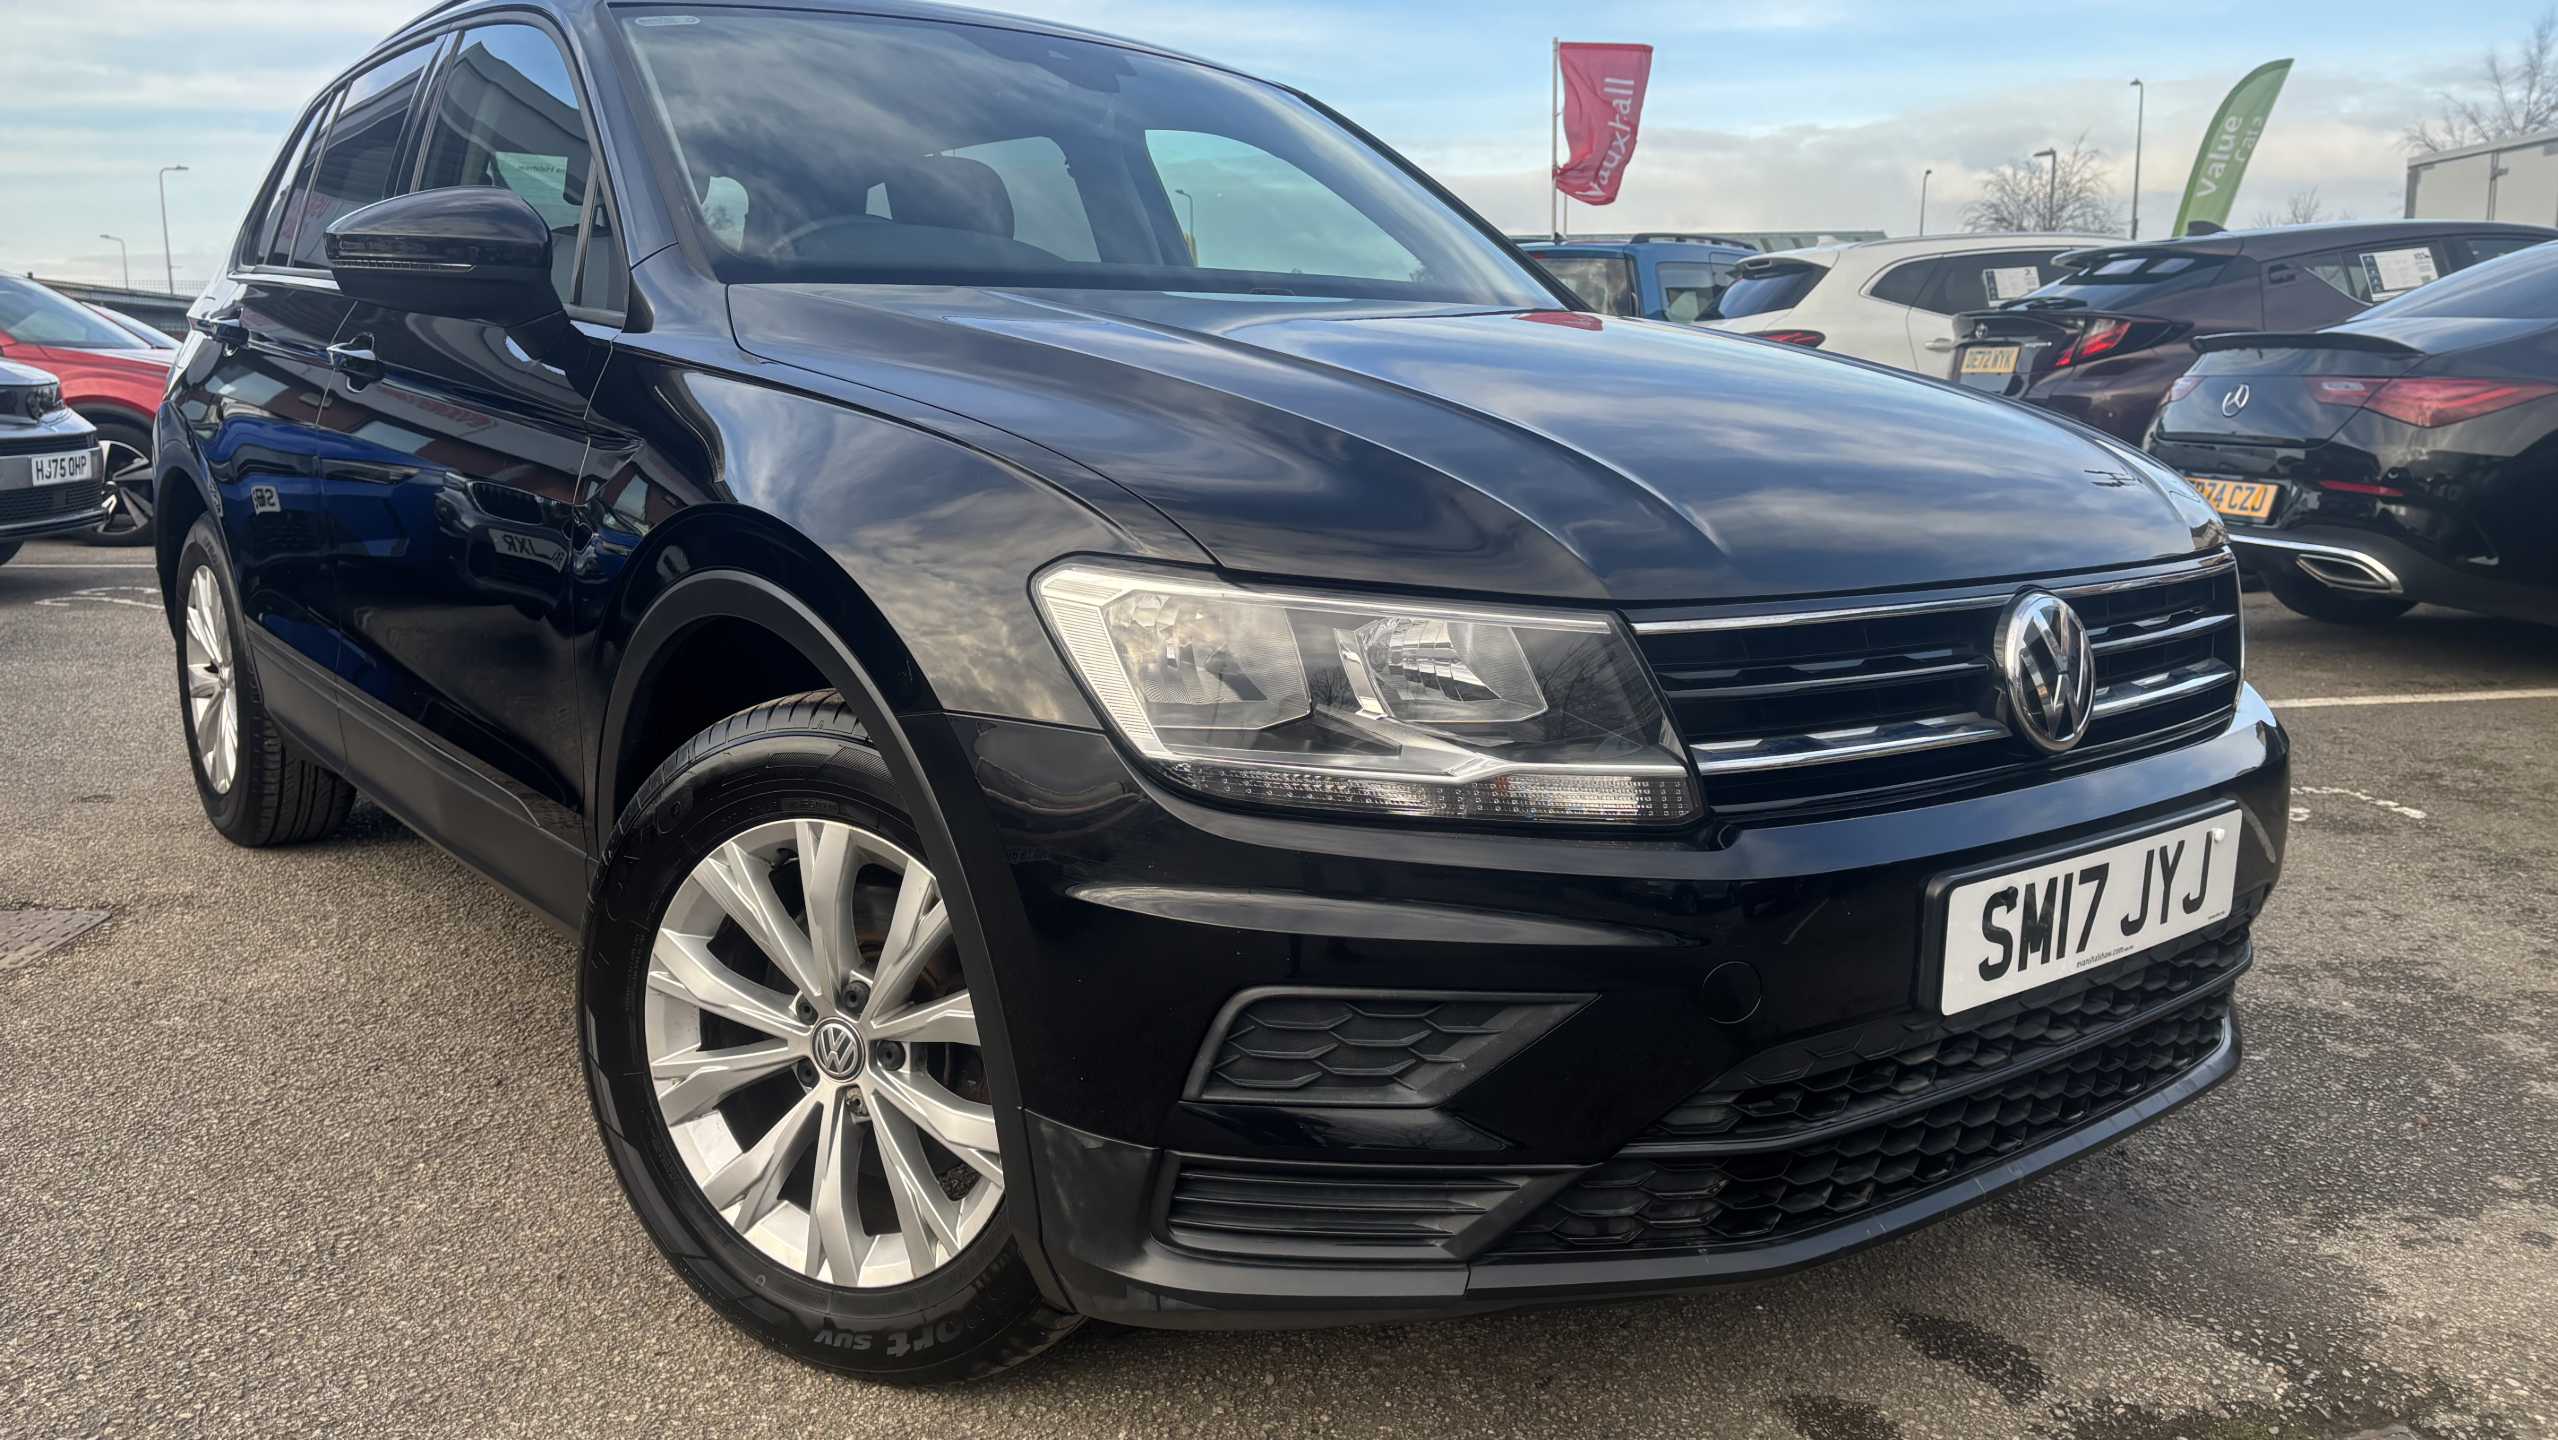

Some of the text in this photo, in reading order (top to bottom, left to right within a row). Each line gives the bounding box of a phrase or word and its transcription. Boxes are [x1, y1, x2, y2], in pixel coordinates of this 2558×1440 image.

[2196, 115, 2242, 198] Value
[35, 458, 66, 481] HJ75
[1979, 831, 2213, 982] SM17 JYJ
